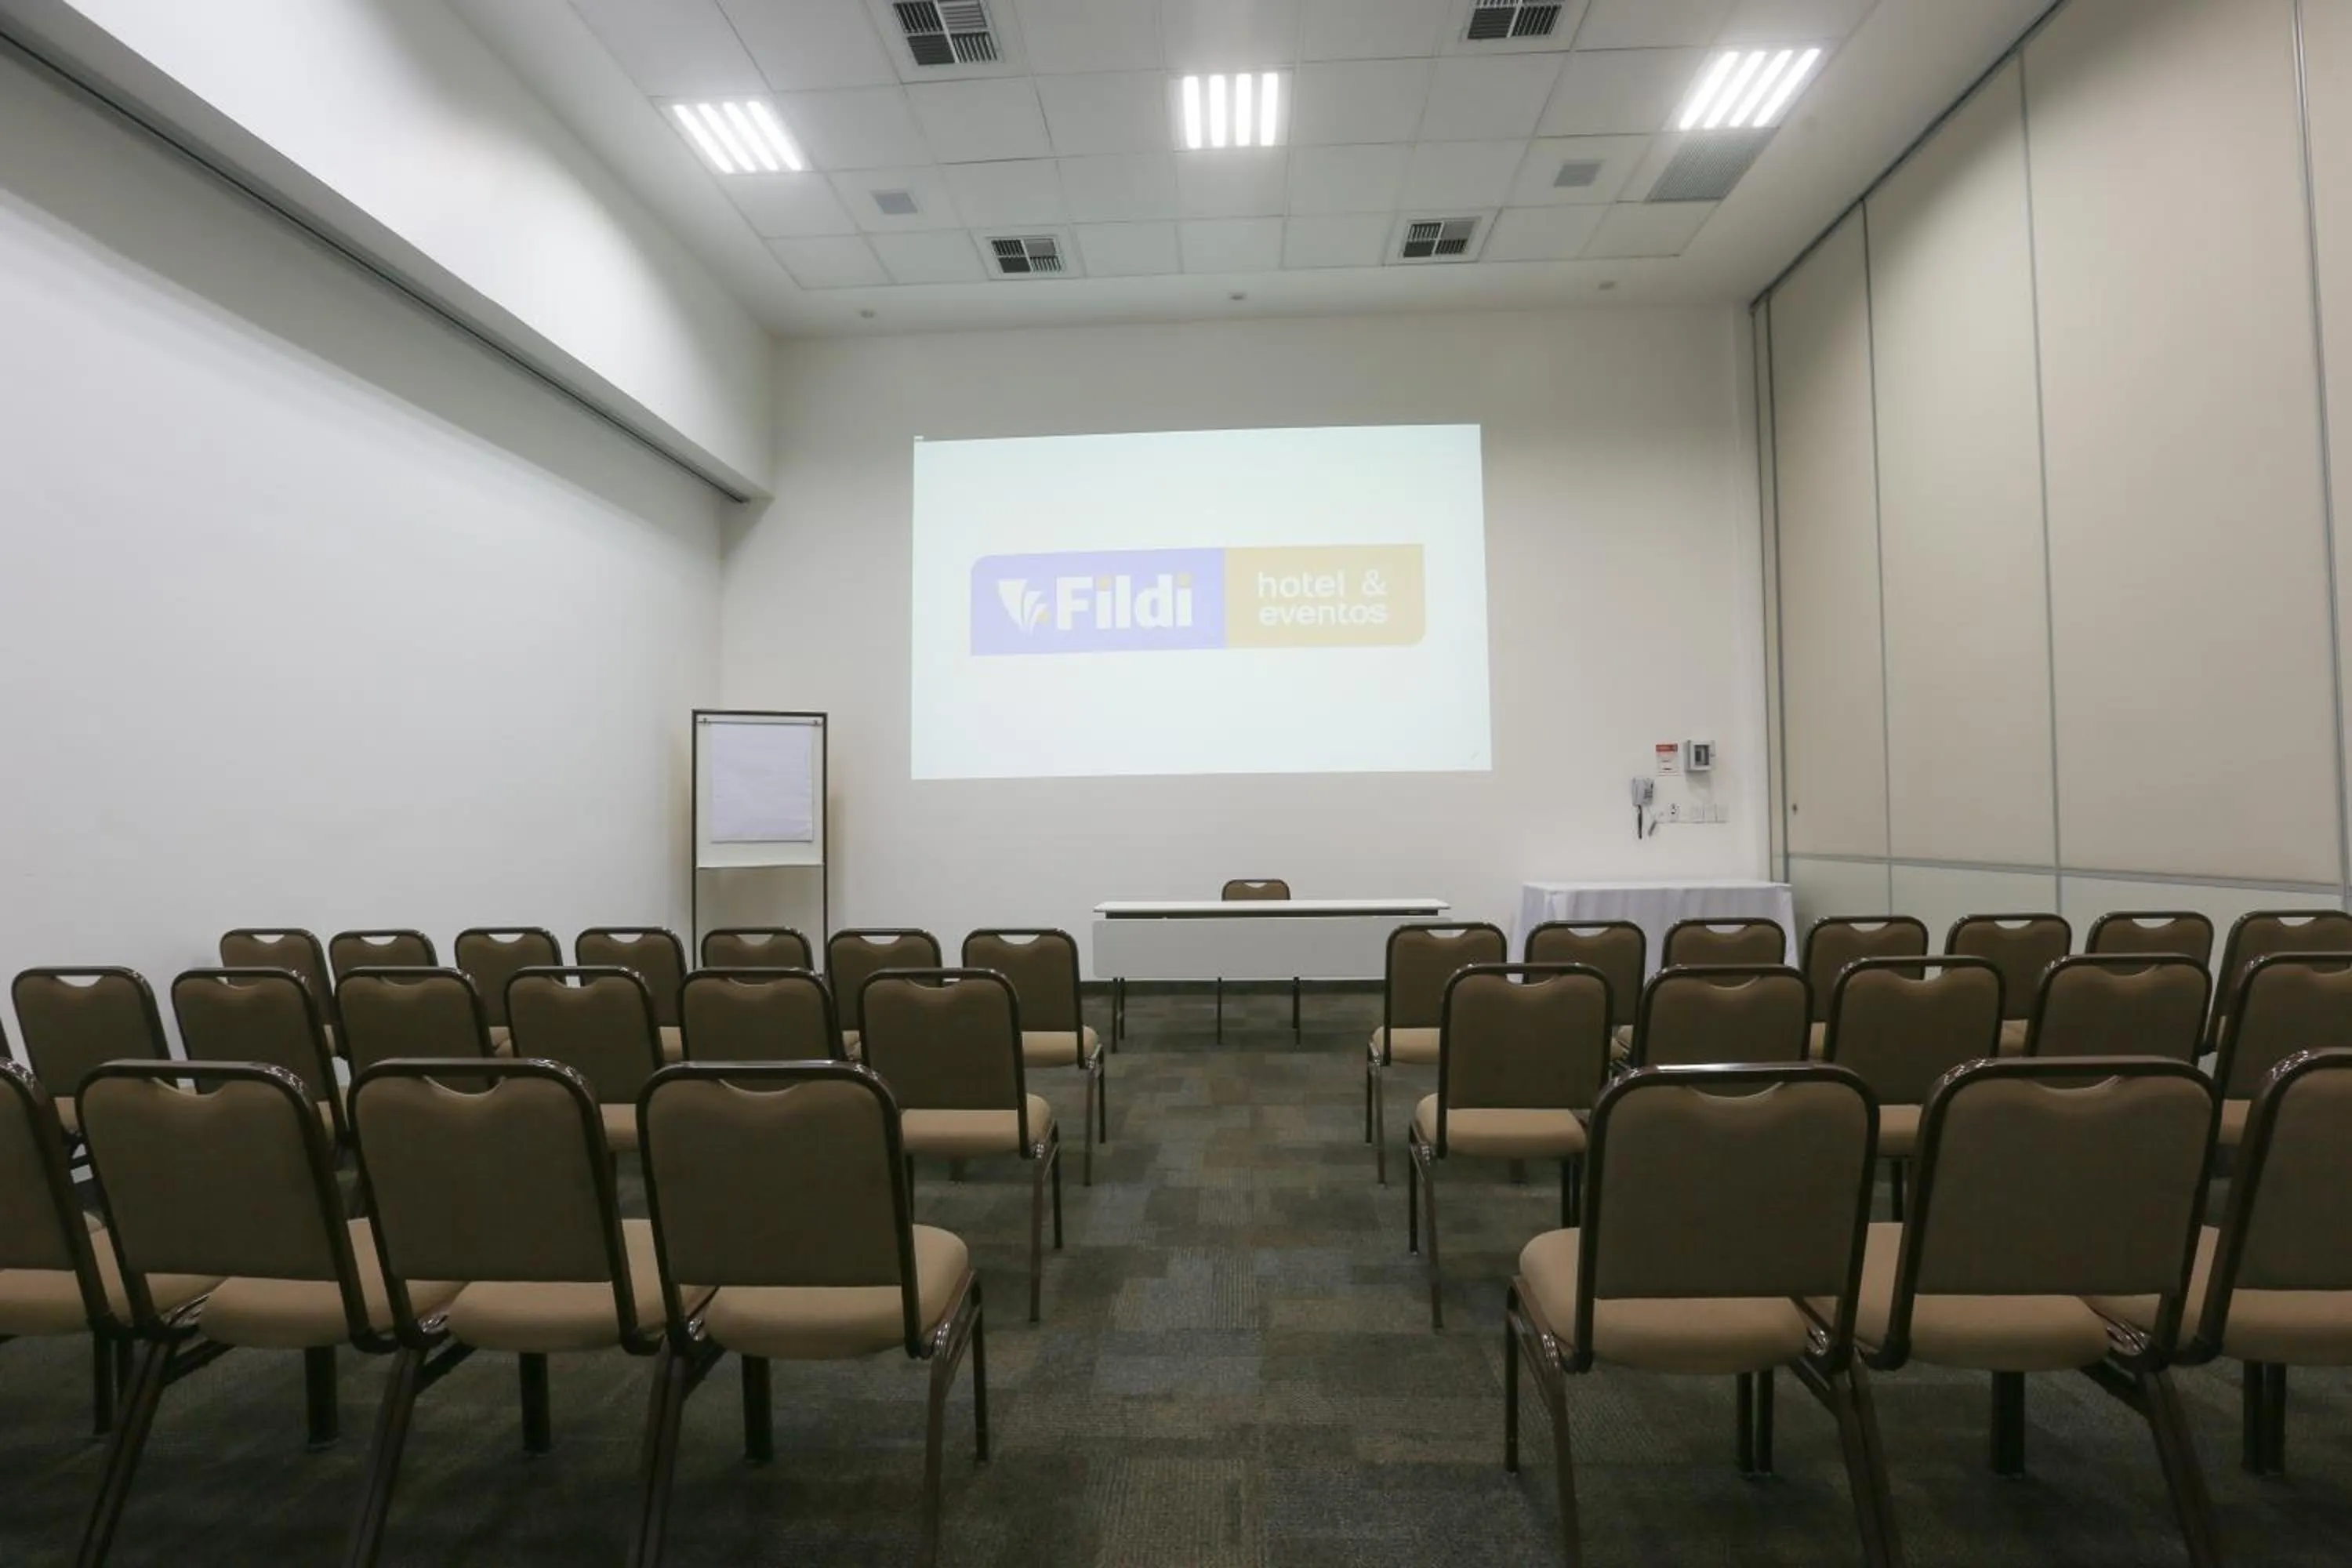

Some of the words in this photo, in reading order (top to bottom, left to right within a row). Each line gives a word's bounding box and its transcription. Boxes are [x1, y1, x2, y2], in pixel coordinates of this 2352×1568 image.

[1258, 571, 1344, 598] hotel
[1363, 569, 1388, 596] &
[1056, 574, 1192, 630] Fildi
[1259, 600, 1388, 626] eventos
